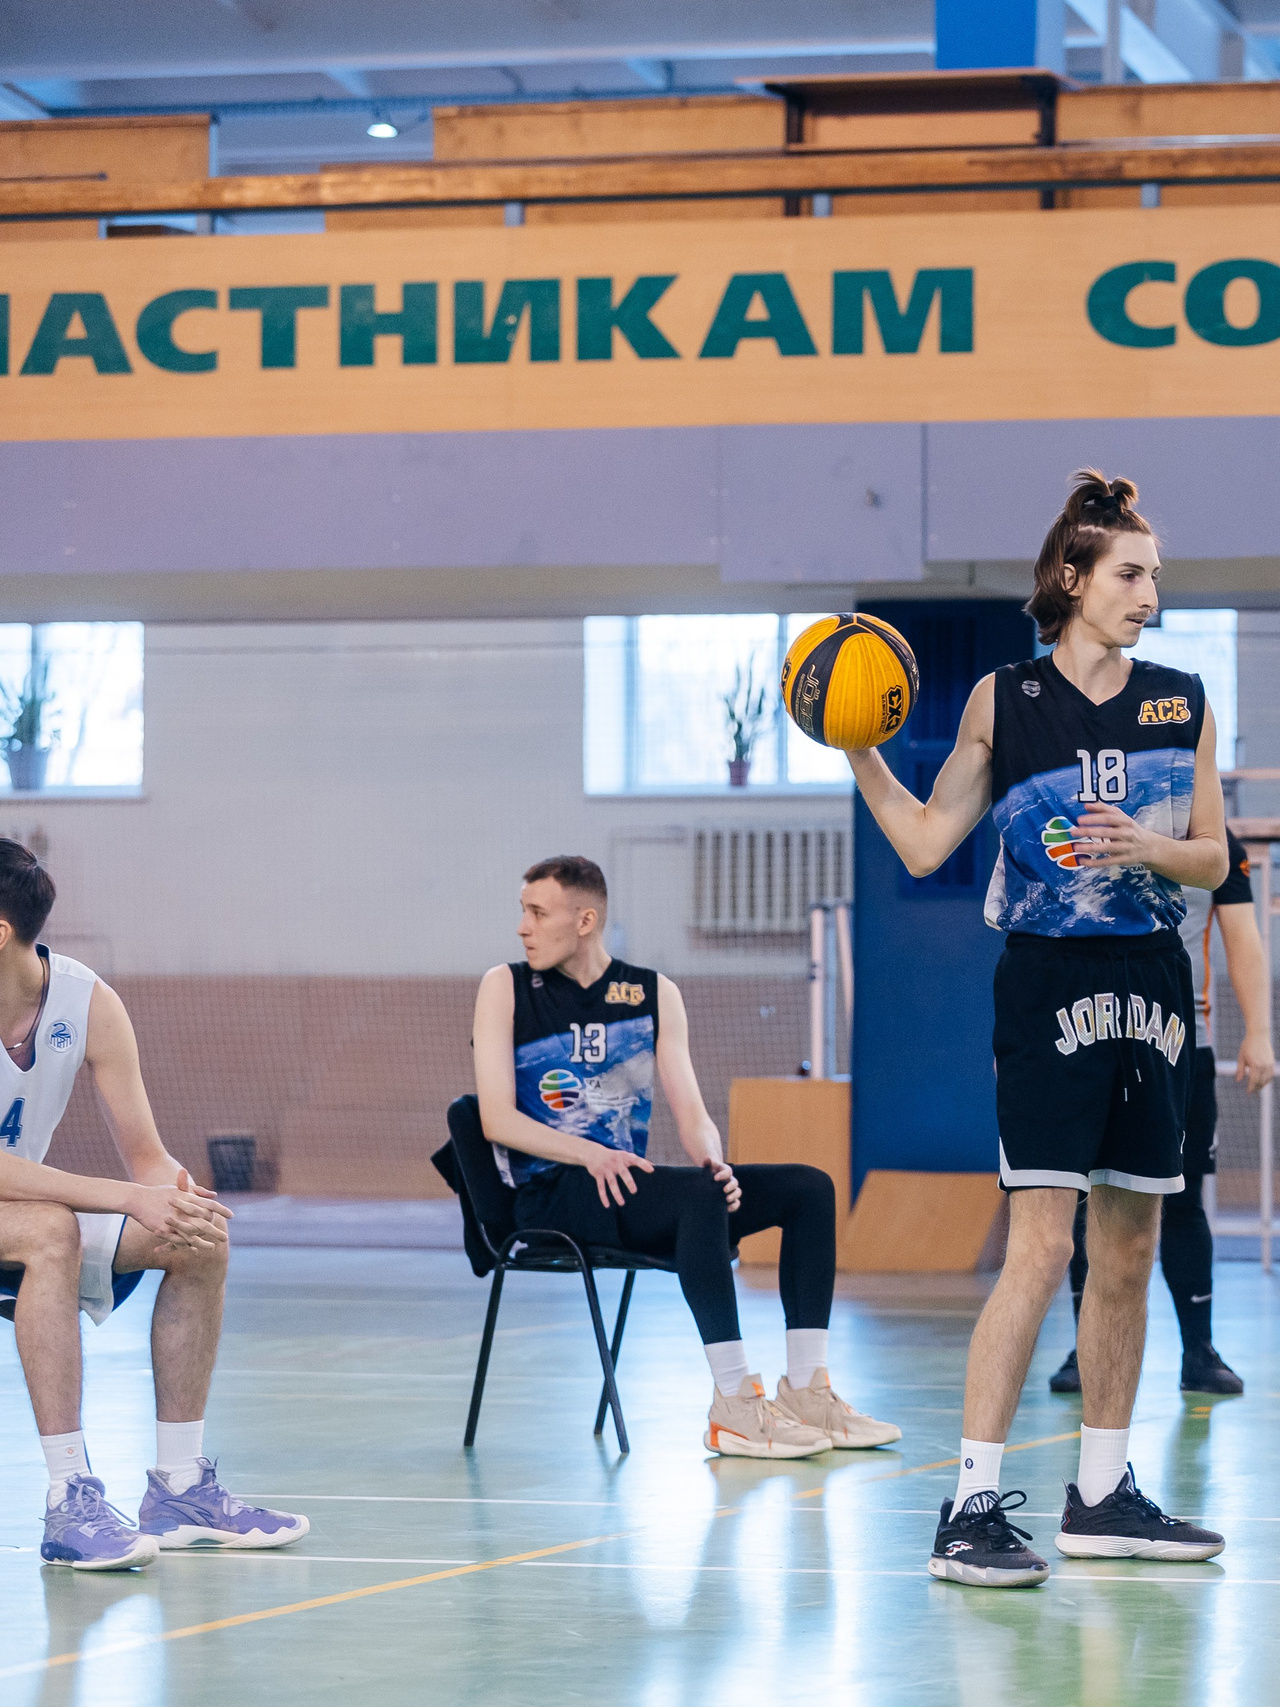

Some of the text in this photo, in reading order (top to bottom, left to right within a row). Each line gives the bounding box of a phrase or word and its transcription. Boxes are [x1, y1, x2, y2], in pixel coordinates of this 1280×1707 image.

[0, 266, 975, 376] АСТНИКАМ
[1077, 749, 1127, 803] 18
[569, 1022, 607, 1063] 13
[1055, 993, 1186, 1067] JORDAN
